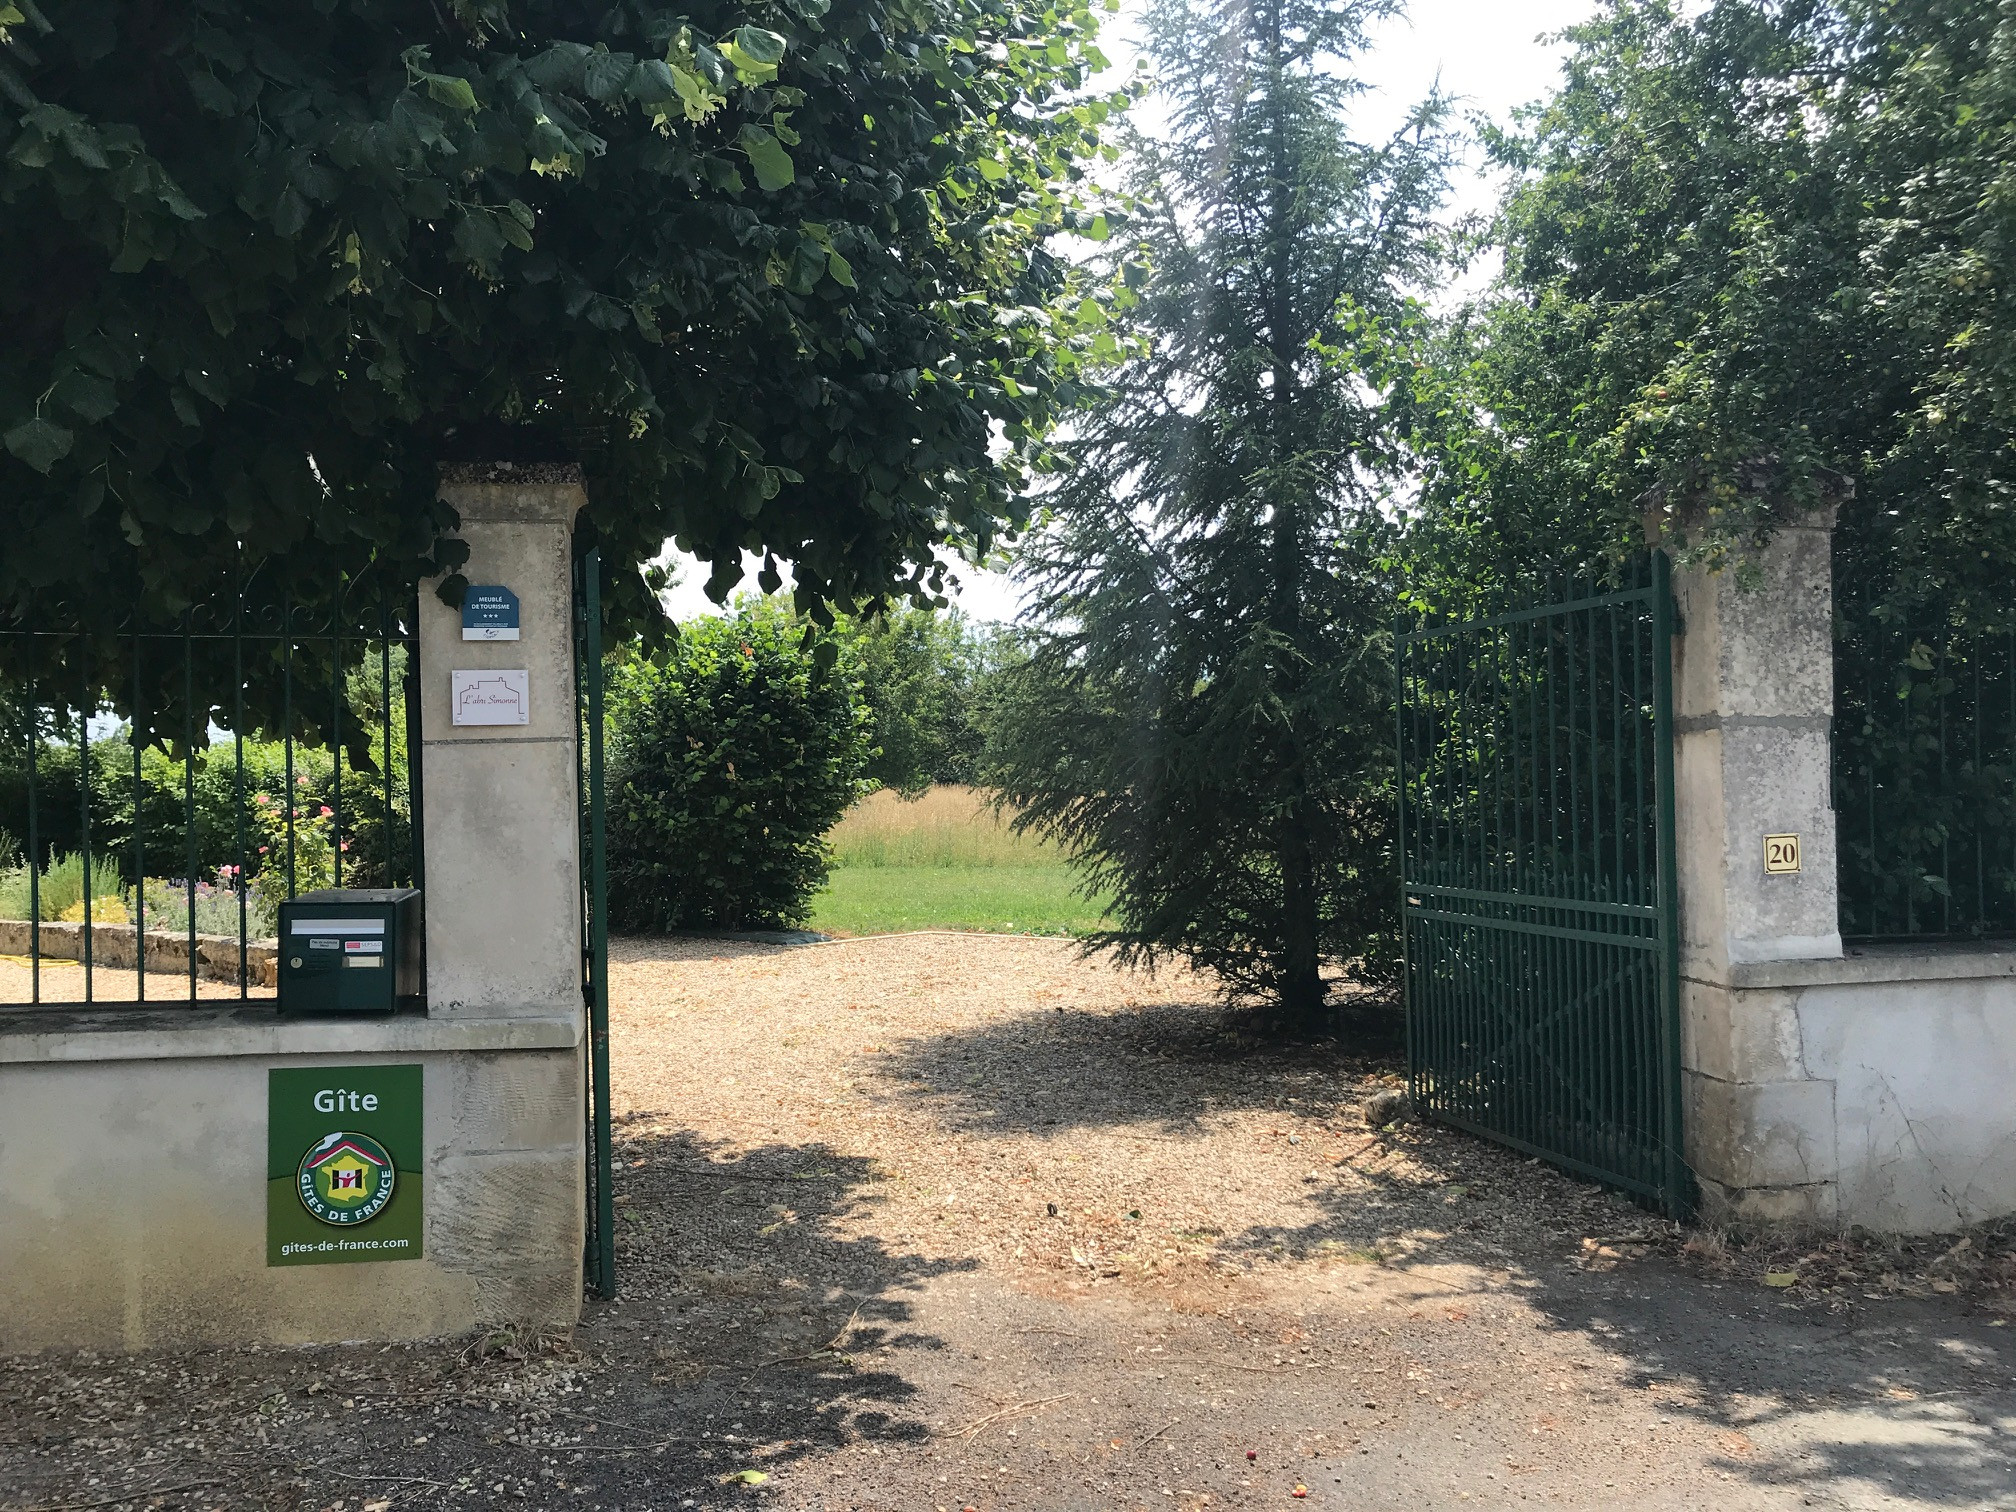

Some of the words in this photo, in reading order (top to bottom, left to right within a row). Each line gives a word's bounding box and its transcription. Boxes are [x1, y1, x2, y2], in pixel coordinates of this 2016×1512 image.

[487, 694, 518, 705] Simonne
[1769, 843, 1796, 864] 20
[313, 1088, 379, 1113] Gîte
[301, 1173, 325, 1214] GÎTES
[328, 1210, 348, 1222] DE
[354, 1170, 392, 1220] FRANCE
[281, 1238, 409, 1256] gites-de-france.com
